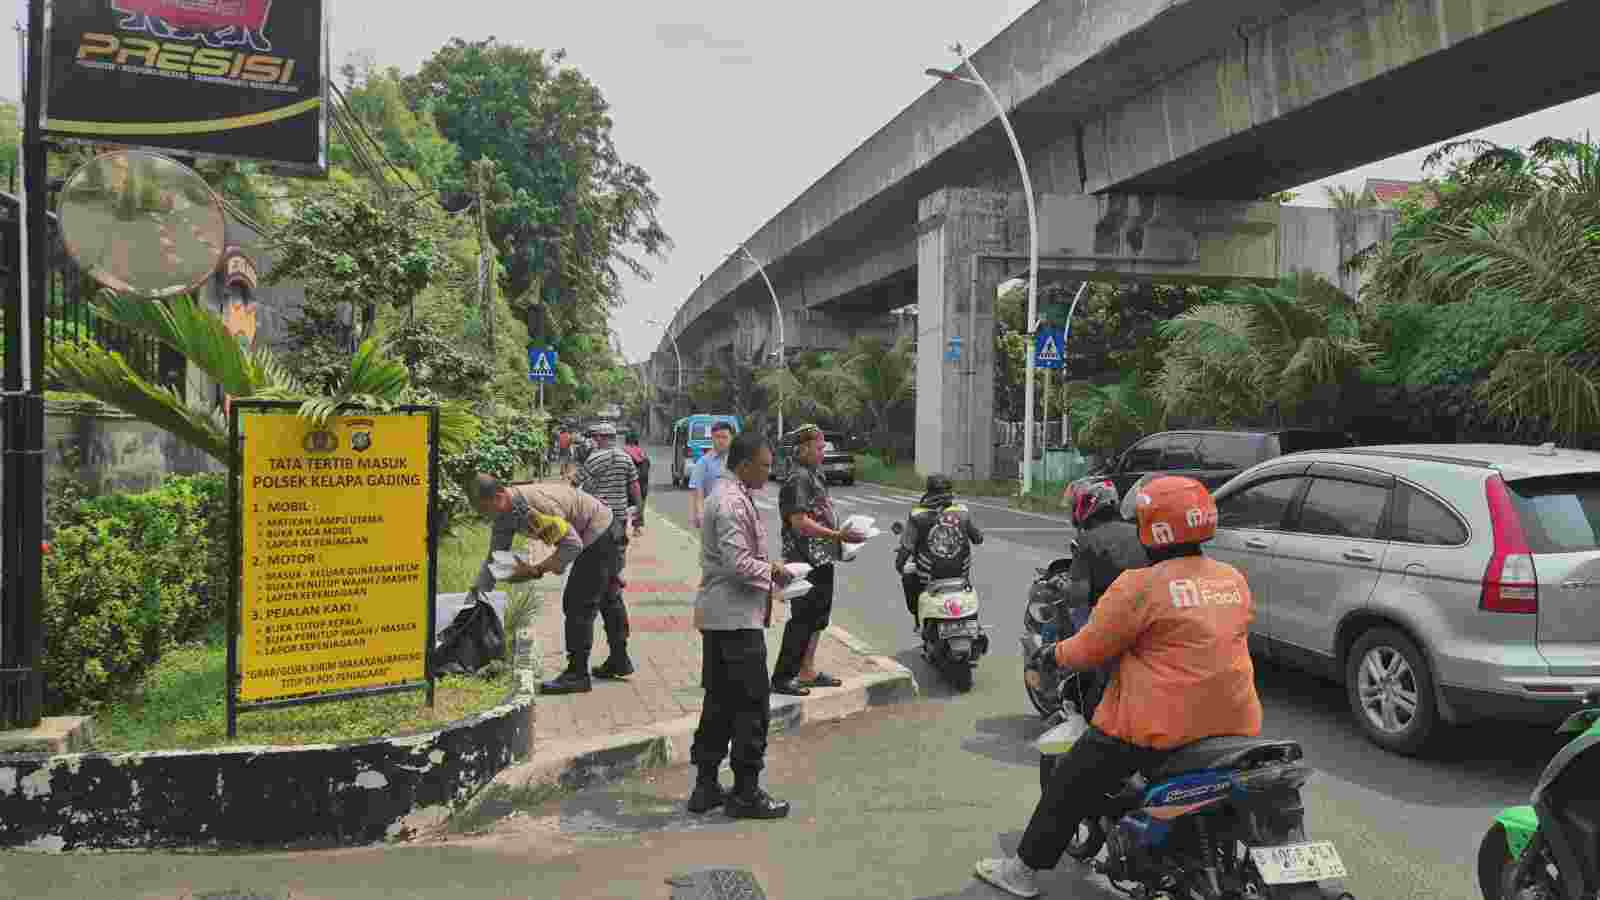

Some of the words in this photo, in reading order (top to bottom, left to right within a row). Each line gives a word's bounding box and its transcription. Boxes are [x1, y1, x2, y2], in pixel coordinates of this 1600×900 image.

[75, 32, 297, 84] PRESISI
[269, 457, 301, 470] TATA
[305, 457, 353, 470] TERTIB
[357, 457, 408, 469] MASUK
[253, 475, 307, 488] POLSEK
[312, 474, 363, 488] KELAPA
[367, 474, 421, 486] GADING
[267, 502, 309, 512] MOBIL
[265, 528, 293, 538] BUKA
[267, 553, 315, 565] MOTOR
[266, 606, 320, 619] PEJALAN
[322, 604, 352, 614] KAKI
